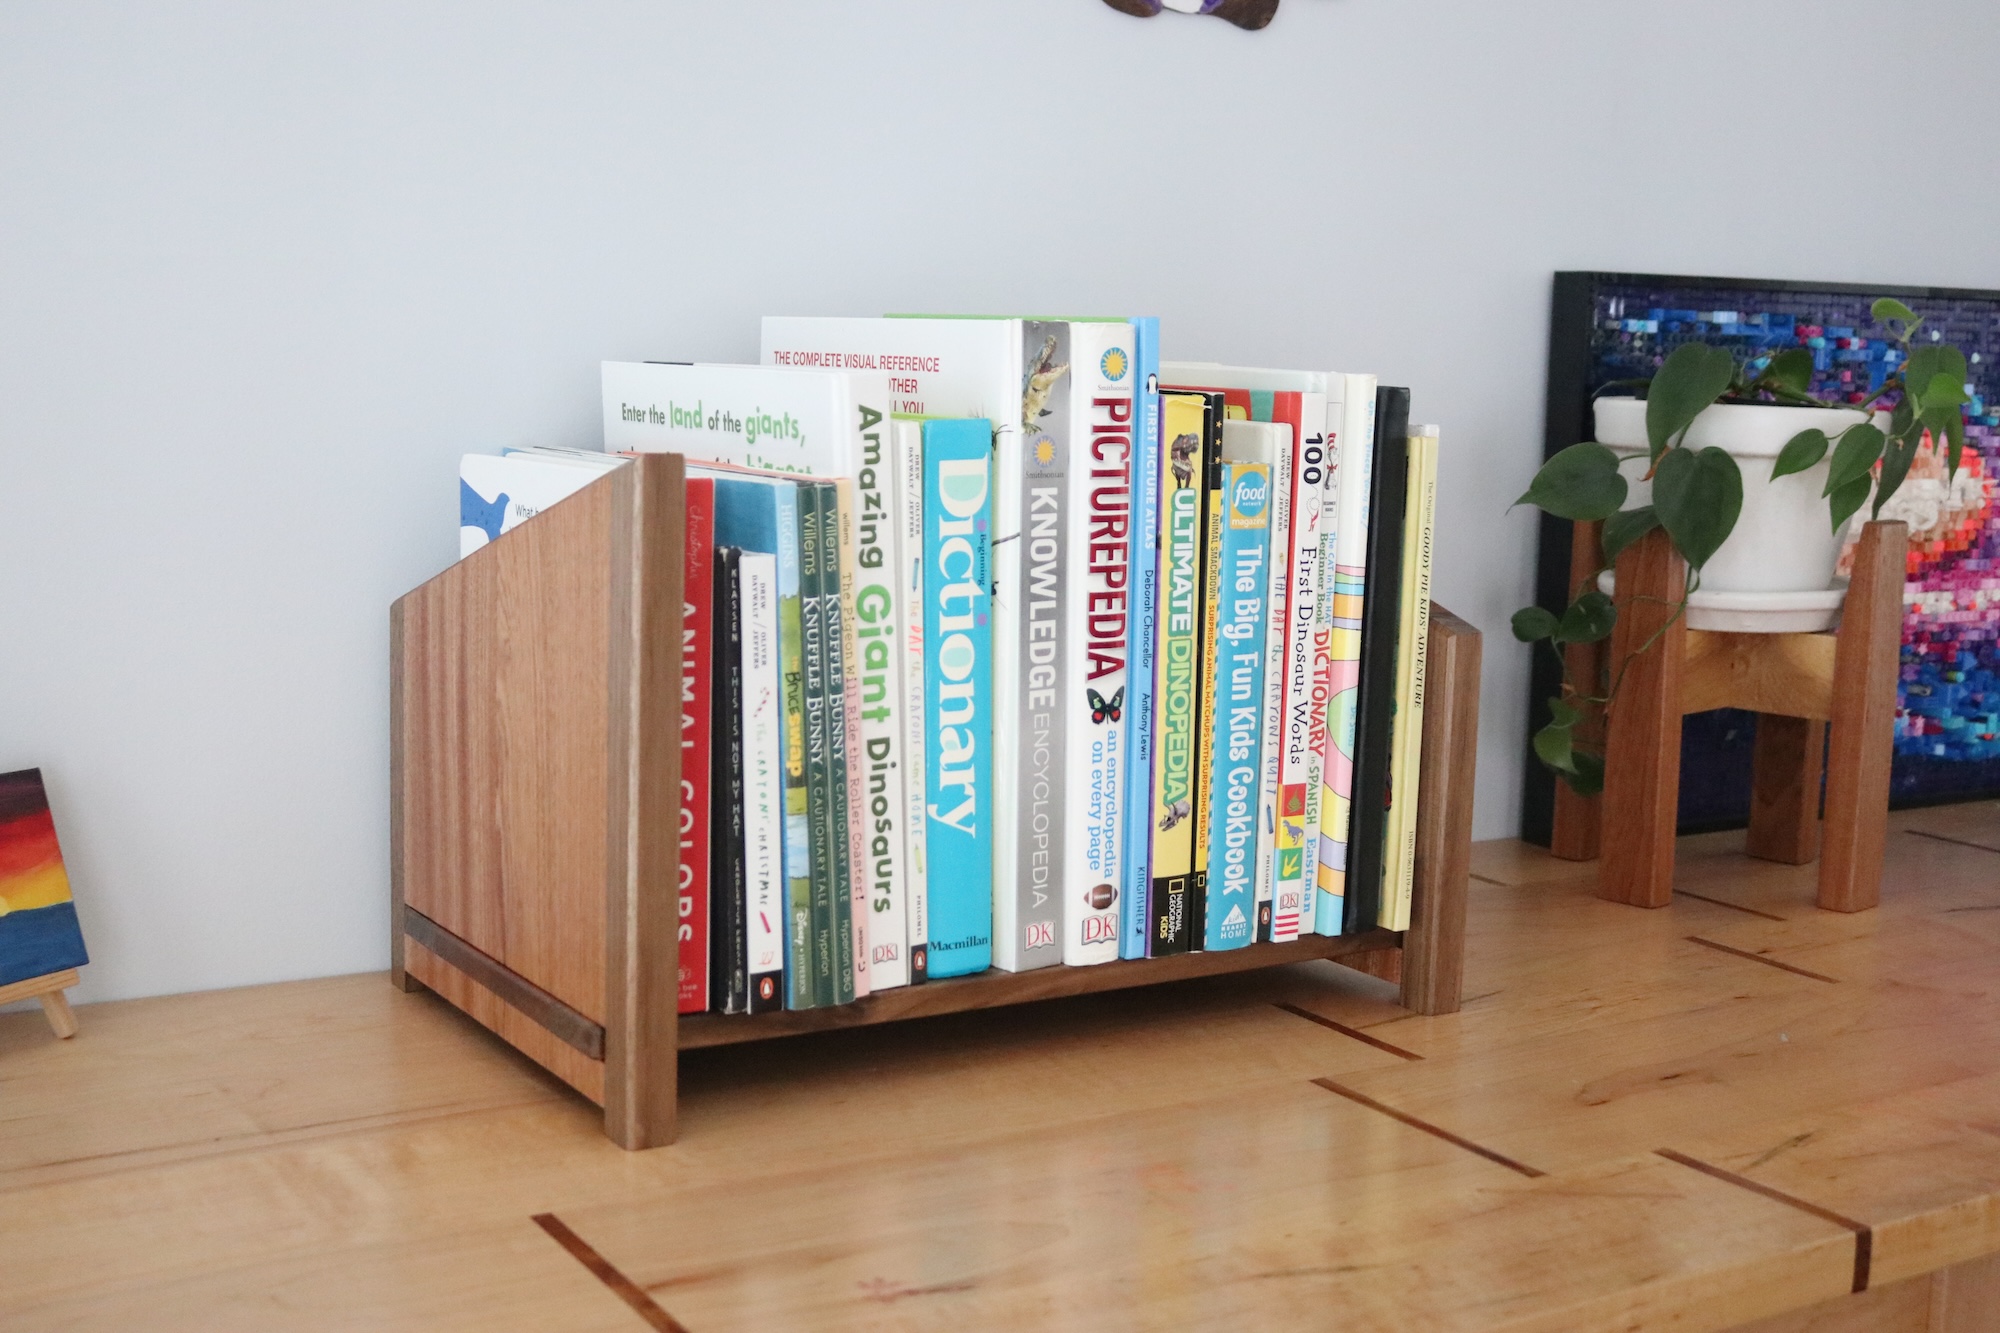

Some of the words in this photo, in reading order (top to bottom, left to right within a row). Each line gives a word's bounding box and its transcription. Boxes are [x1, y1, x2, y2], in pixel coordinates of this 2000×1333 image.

[774, 351, 790, 365] THE
[793, 352, 842, 368] COMPLETE
[844, 354, 877, 369] VISUAL
[879, 355, 940, 372] REFERENCE
[1097, 384, 1130, 392] Smithsonian
[622, 402, 646, 423] Enter
[649, 404, 665, 425] the
[670, 399, 702, 428] land
[708, 409, 719, 430] of
[723, 410, 741, 433] the
[745, 406, 806, 447] giants,
[1147, 404, 1157, 443] FIRST
[1026, 470, 1064, 480] Smithsonian
[1146, 446, 1157, 504] PICTURE
[1303, 432, 1324, 485] 100
[858, 404, 887, 568] Amazing
[1234, 482, 1266, 507] food
[781, 505, 793, 568] HIGGINS
[804, 512, 817, 575] Willems
[826, 508, 837, 572] Willems
[1087, 397, 1132, 681] PICTUREPEDIA
[1144, 508, 1155, 550] ATLAS
[1211, 513, 1219, 544] ANIMAL
[1232, 518, 1266, 528] magazine
[1328, 532, 1336, 549] The
[977, 534, 988, 586] Beginning
[1171, 488, 1195, 632] ULTIMATE
[1209, 546, 1219, 600] SMACKDOWN
[1235, 544, 1263, 592] The
[1299, 547, 1317, 596] First
[1317, 532, 1328, 590] Beginner
[1422, 527, 1431, 571] GOODY
[842, 572, 852, 600] The
[1028, 486, 1058, 710] KNOWLEDGE
[1144, 570, 1154, 612] Deborah
[1274, 573, 1286, 598] THE
[1326, 587, 1334, 602] the
[1328, 574, 1334, 584] in
[1421, 574, 1429, 595] PIE
[731, 568, 739, 642] KLASSEN
[1222, 597, 1261, 647] Big,
[1271, 609, 1286, 635] DAY
[1315, 592, 1325, 625] Book
[1419, 598, 1429, 630] KIDS'
[752, 629, 760, 669] JEFFERS
[803, 596, 821, 690] KNUFFLE
[825, 593, 841, 686] KNUFFLE
[843, 606, 855, 659] Pigeon
[856, 584, 894, 723] Giant
[927, 452, 988, 838] Dictionary
[1142, 615, 1153, 669] Chancellor
[1207, 605, 1215, 656] SURPRISING
[1293, 604, 1313, 696] Dinosaur
[731, 666, 739, 708] THIS
[845, 665, 857, 698] Will
[1231, 652, 1259, 701] Fun
[1309, 629, 1331, 758] DICTIONARY
[1414, 633, 1426, 710] ADVENTURE
[732, 717, 739, 736] IS
[806, 695, 824, 765] BUNNY
[829, 693, 844, 760] BUNNY
[847, 705, 859, 740] Ride
[1138, 693, 1151, 733] Anthony
[1167, 639, 1191, 801] DINOPEDIA
[1268, 671, 1282, 746] CRAYONS
[1290, 700, 1308, 765] Words
[1092, 740, 1103, 764] on
[1107, 730, 1117, 752] an
[1140, 734, 1149, 761] Lewis
[1228, 706, 1256, 762] Kids
[813, 772, 822, 780] A
[836, 768, 844, 776] A
[848, 746, 860, 771] the
[1266, 756, 1279, 795] QUIT
[1311, 756, 1318, 765] in
[732, 780, 740, 798] MY
[850, 777, 862, 825] Roller
[1032, 712, 1050, 909] ENCYCLOPEDIA
[1088, 768, 1102, 819] every
[1201, 763, 1209, 813] SURPRISING
[1306, 766, 1320, 825] SPANISH
[732, 804, 741, 836] HAT
[813, 786, 827, 870] CAUTIONARY
[835, 783, 848, 862] CAUTIONARY
[866, 736, 897, 912] Dinosaurs
[1104, 757, 1117, 879] encyclopedia
[1199, 815, 1207, 849] RESULTS
[1223, 767, 1254, 896] Cookbook
[852, 833, 865, 900] Coaster!
[1086, 826, 1101, 871] page
[817, 877, 828, 907] TALE
[839, 872, 849, 902] TALE
[1136, 866, 1145, 925] KINGFISHER
[1303, 838, 1317, 914] Eastman
[1168, 894, 1177, 943] GEOGRAPHIC
[1175, 894, 1183, 932] NATIONAL
[1281, 894, 1298, 907] DK
[839, 919, 850, 966] Hyperion
[928, 935, 989, 952] Macmillan
[1026, 922, 1053, 947] DK
[1085, 915, 1116, 941] DK
[1160, 915, 1168, 939] KIDS
[1220, 929, 1246, 939] HOME
[819, 929, 829, 977] Hyperion
[875, 944, 895, 960] DK
